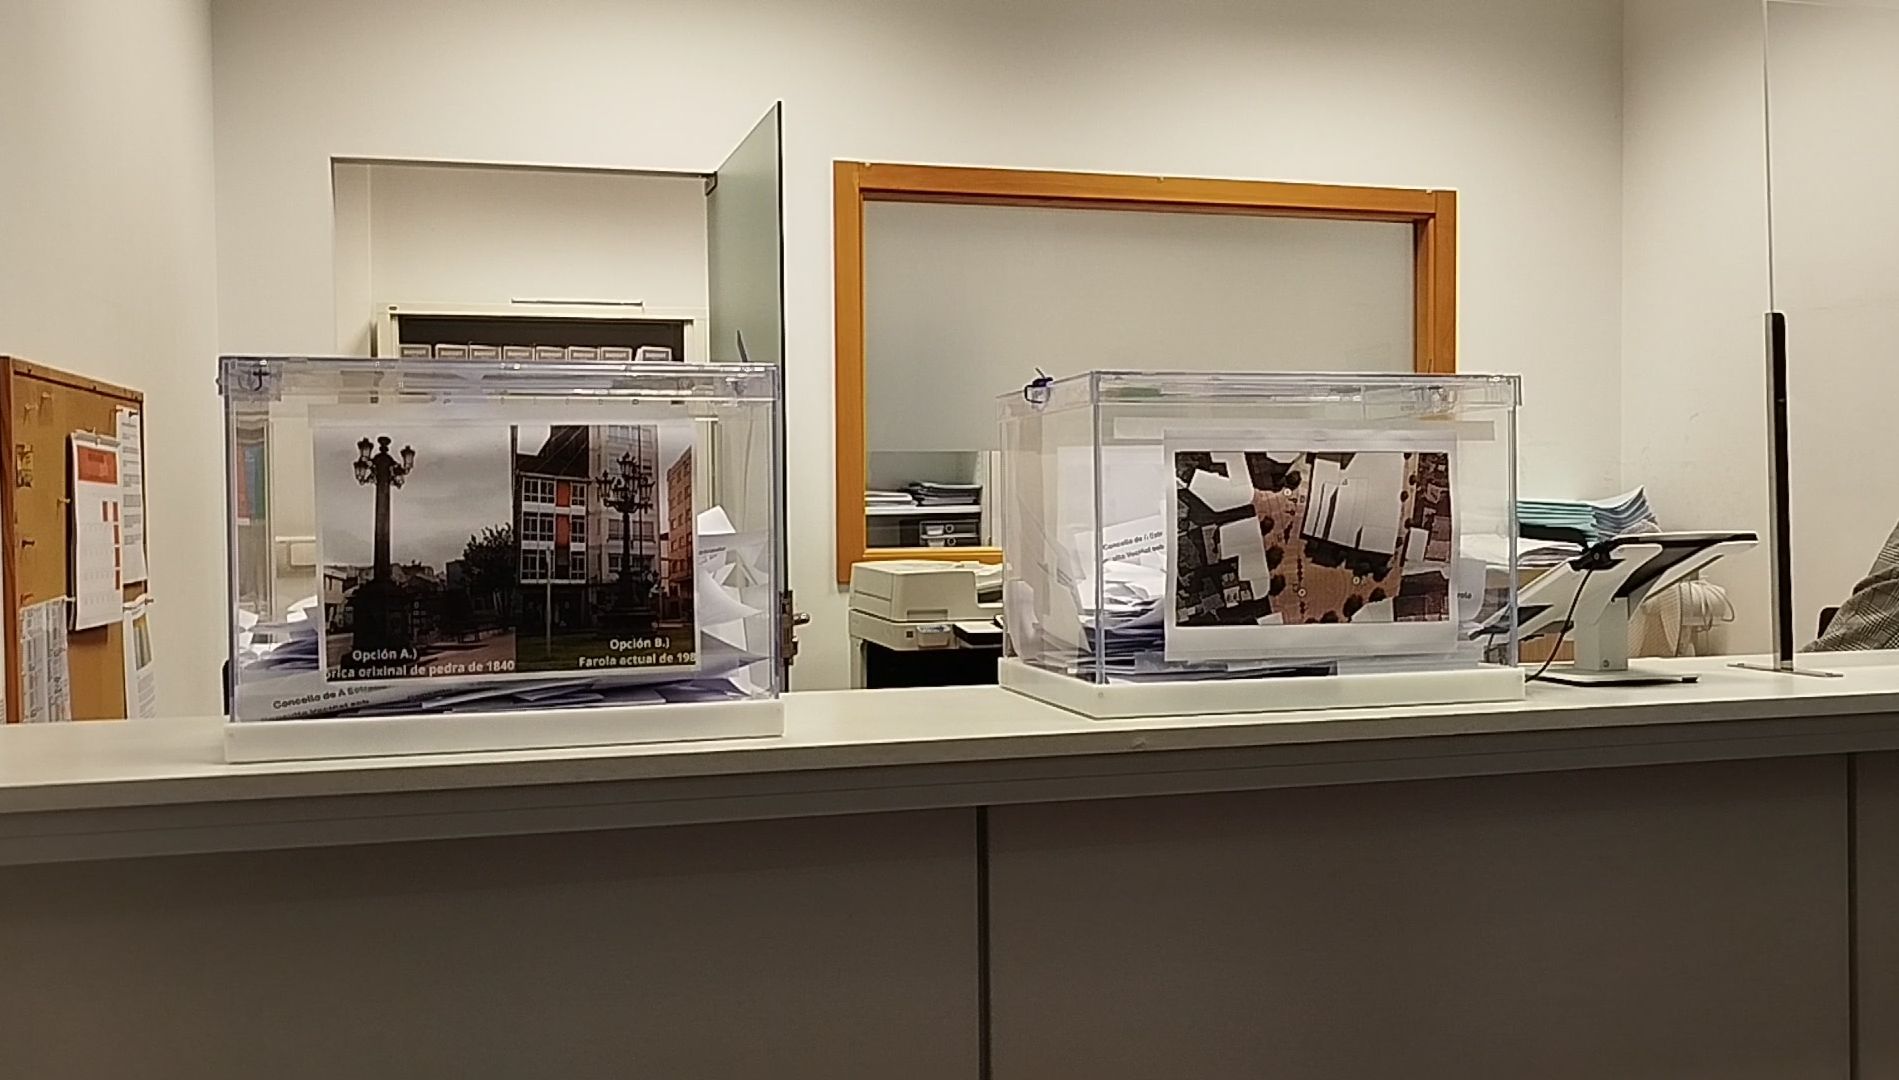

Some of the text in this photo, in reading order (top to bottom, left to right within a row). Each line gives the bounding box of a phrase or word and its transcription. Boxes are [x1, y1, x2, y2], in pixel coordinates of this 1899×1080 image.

[609, 637, 670, 652] Opción B.)
[352, 648, 418, 663] Opción A.)
[578, 655, 617, 668] Farola
[619, 652, 657, 666] actual
[659, 652, 674, 664] de
[358, 664, 407, 679] orixinal
[410, 663, 426, 675] de
[428, 661, 465, 677] pedra
[468, 660, 483, 672] de
[486, 659, 516, 671] 1840
[272, 693, 321, 709] Concello
[323, 691, 337, 700] de
